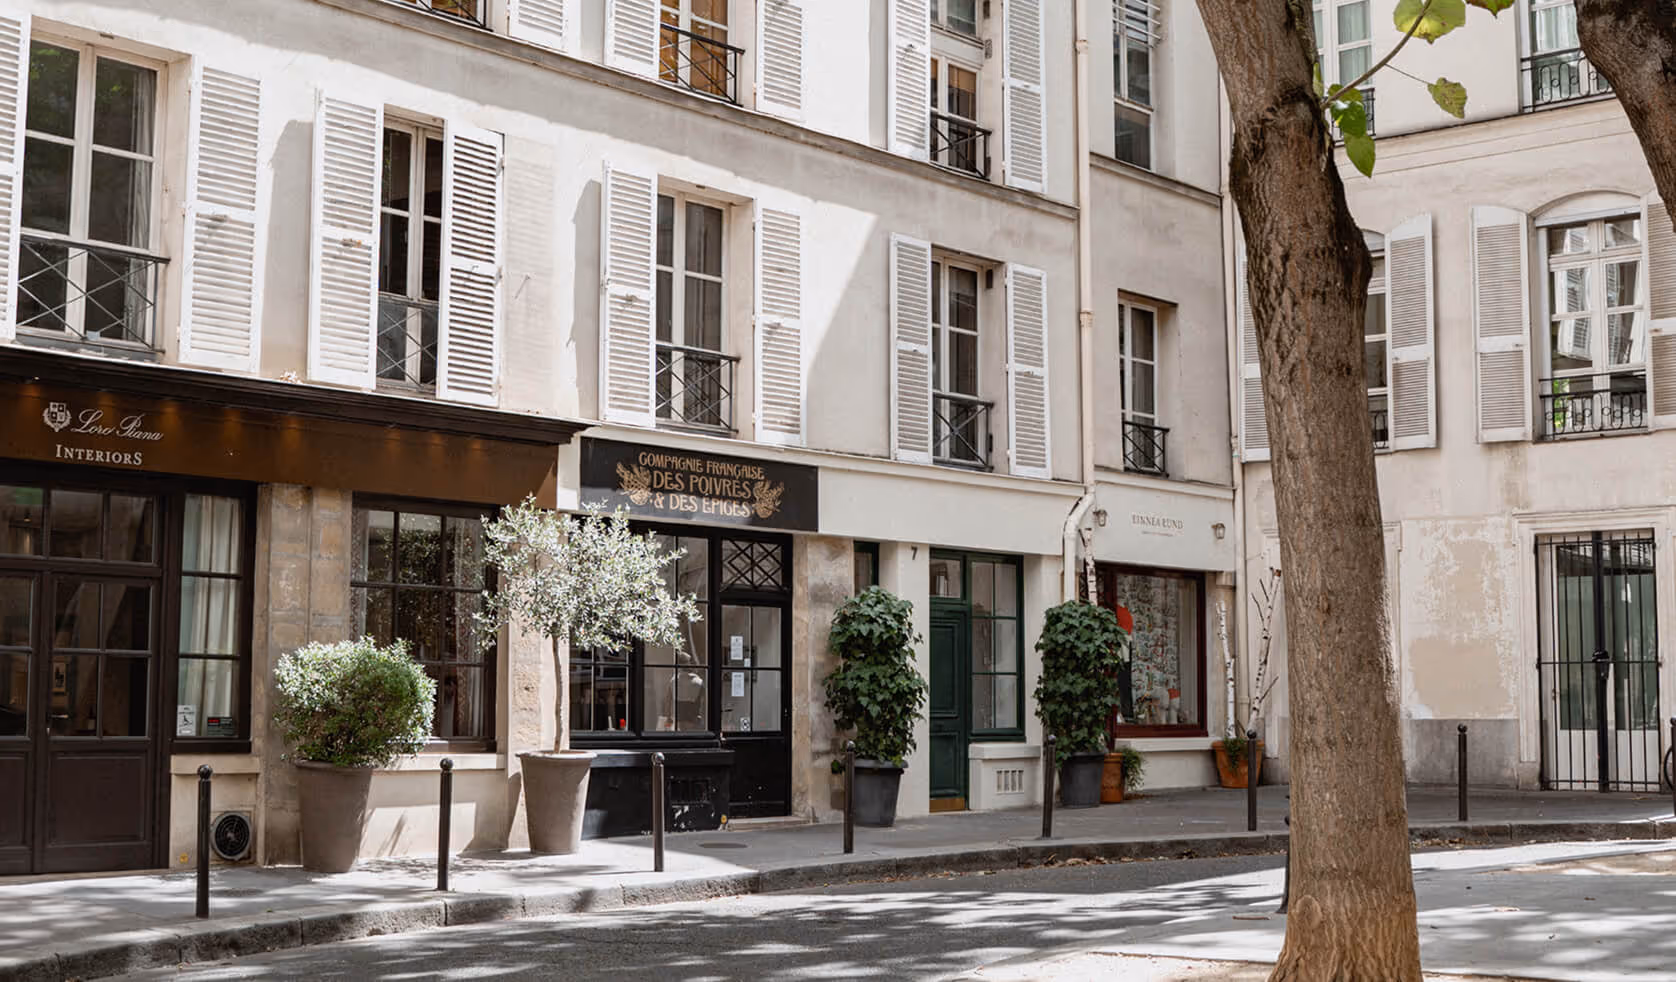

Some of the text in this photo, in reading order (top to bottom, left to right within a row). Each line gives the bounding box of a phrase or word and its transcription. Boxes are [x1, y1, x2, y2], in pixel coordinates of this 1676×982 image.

[70, 408, 164, 441] Loro Piana
[638, 451, 765, 480] COMPAGNIE FRANÇAISE
[652, 470, 752, 499] DES POIVRES
[654, 491, 665, 509] &
[669, 493, 698, 513] DES
[911, 545, 918, 560] 7
